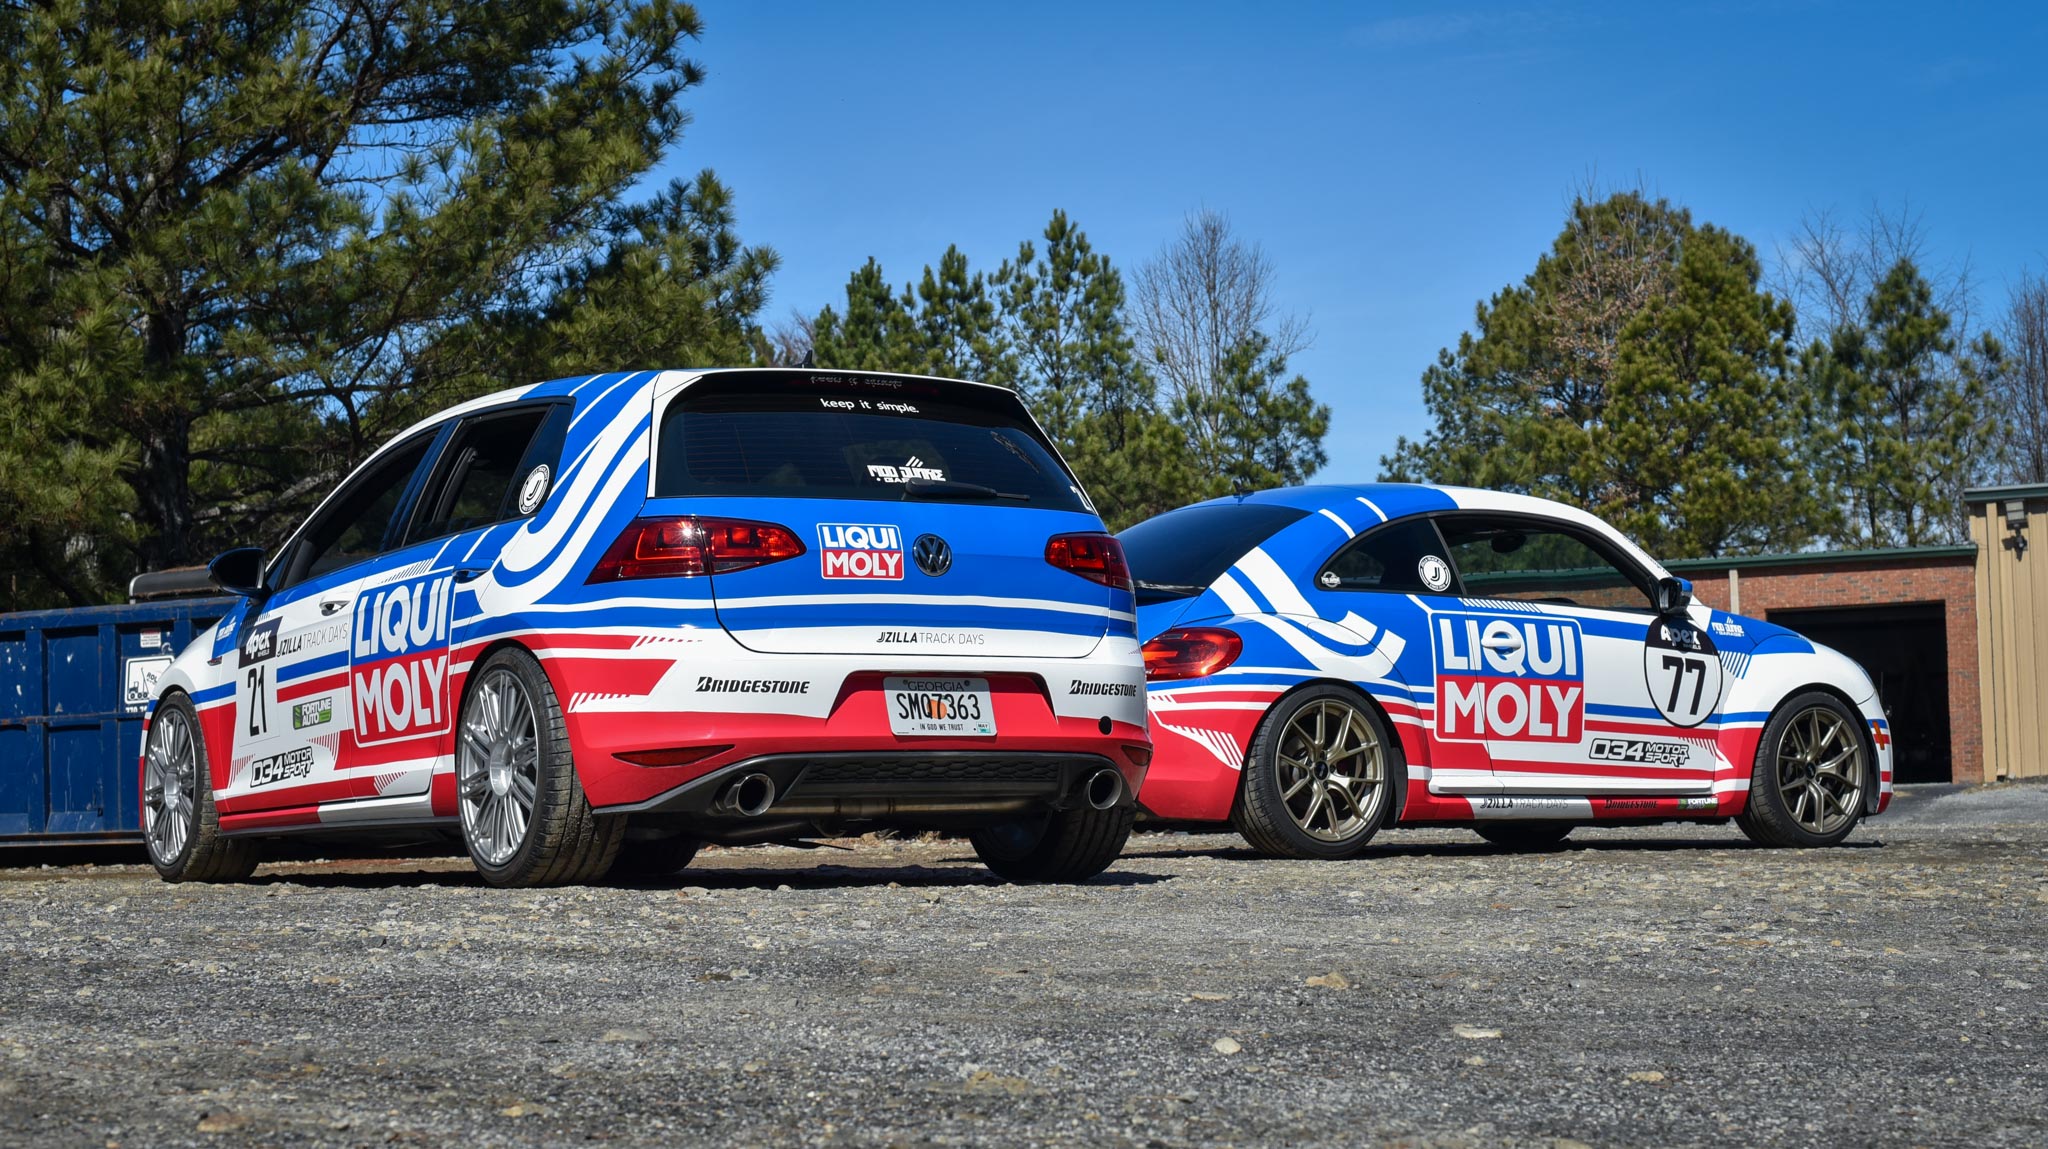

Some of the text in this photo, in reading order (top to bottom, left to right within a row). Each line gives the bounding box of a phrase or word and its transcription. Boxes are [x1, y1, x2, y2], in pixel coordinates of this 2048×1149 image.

[820, 398, 920, 414] keep it simple.
[821, 525, 899, 550] LIQUI
[825, 551, 902, 577] MOLY
[354, 575, 453, 659] LIQUI
[303, 630, 328, 650] TRACK
[328, 623, 348, 643] DAYS
[920, 632, 955, 644] TRACK
[958, 633, 985, 645] DAYS
[1438, 618, 1577, 677] LIQUI
[695, 676, 811, 694] BRIDGESTONE
[907, 681, 965, 691] GEORGIA
[1068, 679, 1137, 697] BRIDGESTONE
[1662, 655, 1707, 716] 77
[247, 665, 267, 737] 21
[354, 655, 448, 736] MOLY
[301, 699, 331, 716] FORTUNE
[1444, 681, 1582, 738] MOLY
[302, 712, 320, 727] AUTO
[284, 747, 312, 766] MOTOR
[1589, 739, 1689, 761] 034 MOTOR
[1644, 752, 1686, 767] SPORT
[284, 760, 312, 778] SPORT
